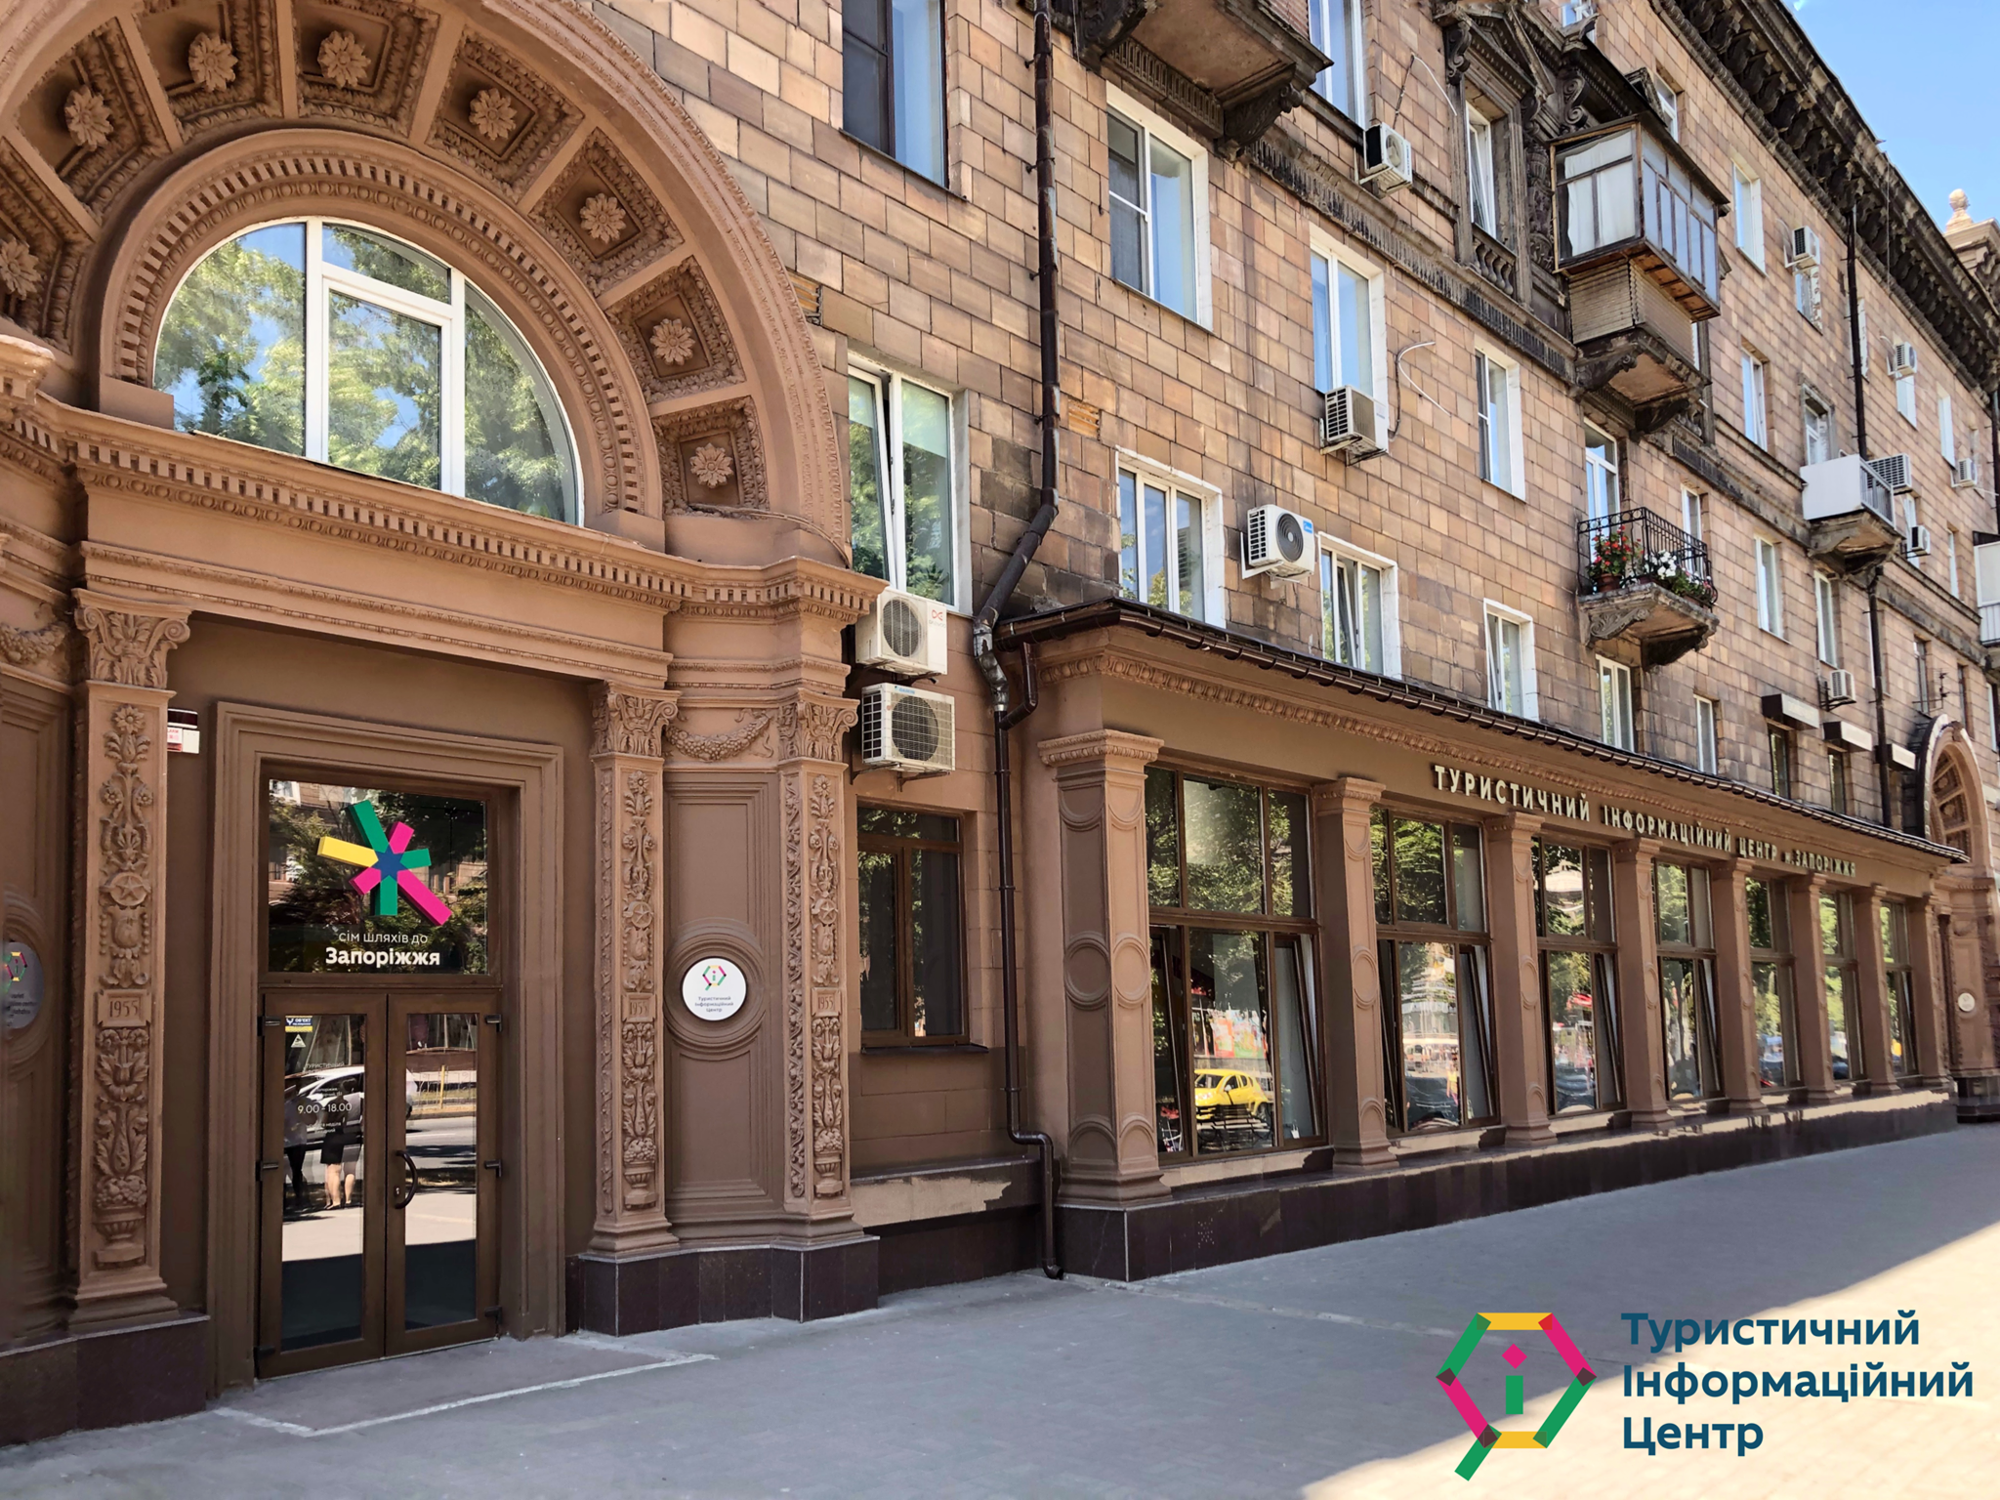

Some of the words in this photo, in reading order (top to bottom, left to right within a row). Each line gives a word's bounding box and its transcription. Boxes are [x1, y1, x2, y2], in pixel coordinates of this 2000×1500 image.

[1434, 765, 1590, 822] ТУРИСТИЧНИЙ
[1603, 805, 1731, 853] ІНФОРМАЦІЙНИЙ
[1738, 836, 1778, 861] ЦЕНТР
[338, 932, 360, 943] сім
[363, 931, 409, 944] шляхів
[411, 934, 428, 945] до
[325, 946, 441, 968] Запоріжжя
[109, 1000, 138, 1018] 1955
[297, 1103, 320, 1115] 9.00
[327, 1102, 353, 1113] 18.00
